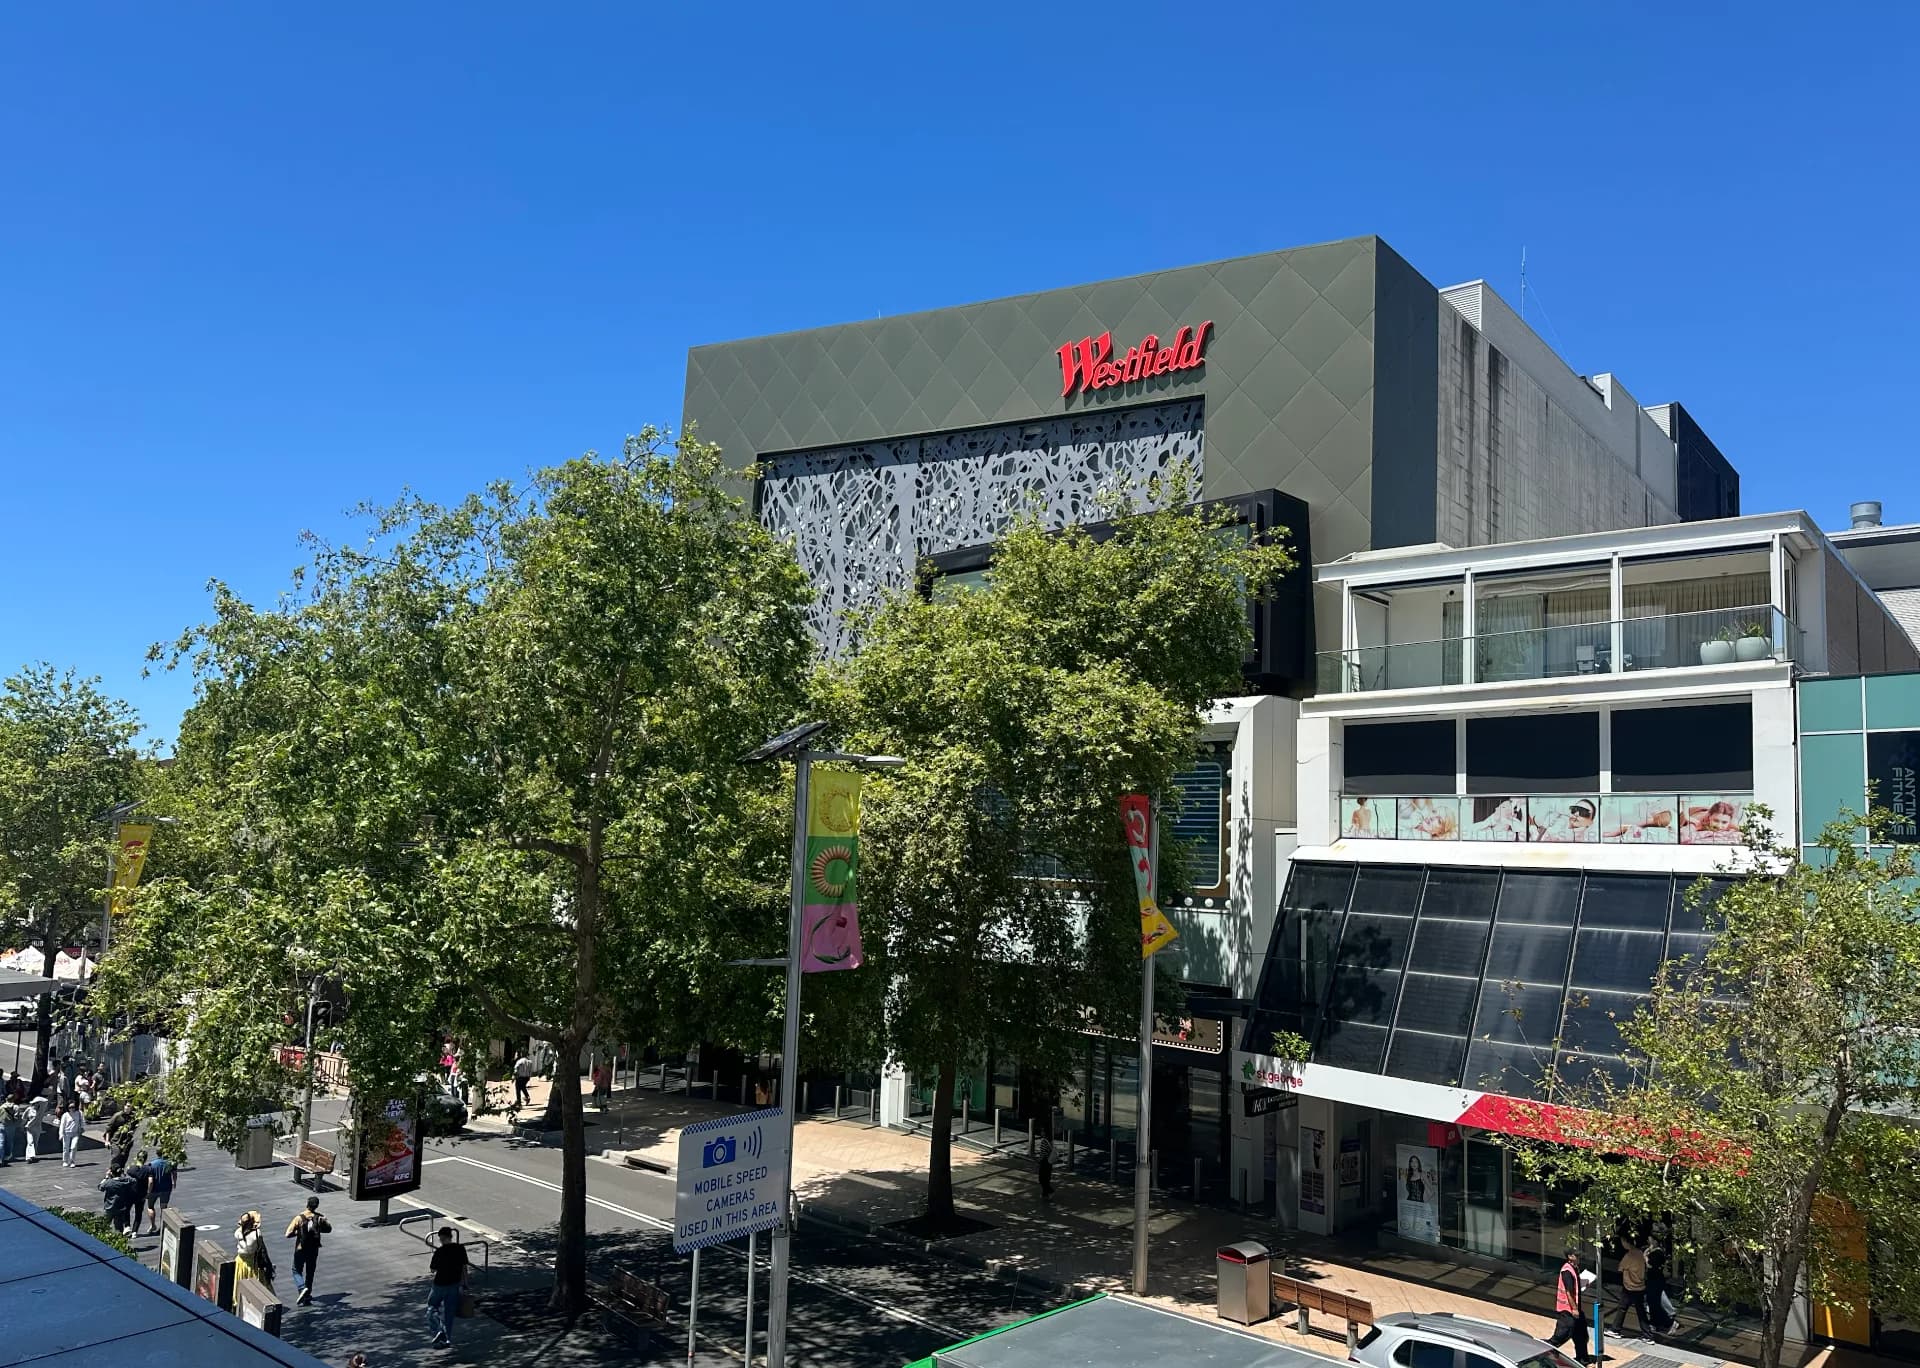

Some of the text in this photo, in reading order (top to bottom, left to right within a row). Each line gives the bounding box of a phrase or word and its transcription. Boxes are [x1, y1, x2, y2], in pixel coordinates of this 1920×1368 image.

[1056, 320, 1214, 398] Westfield
[1891, 767, 1904, 836] FITNES
[1904, 767, 1917, 836] ANYTIME
[394, 1172, 410, 1181] KFC
[694, 1166, 768, 1196] MOBILE SPEED
[706, 1188, 755, 1212] CAMERAS
[680, 1201, 778, 1239] USED IN THIS AREA
